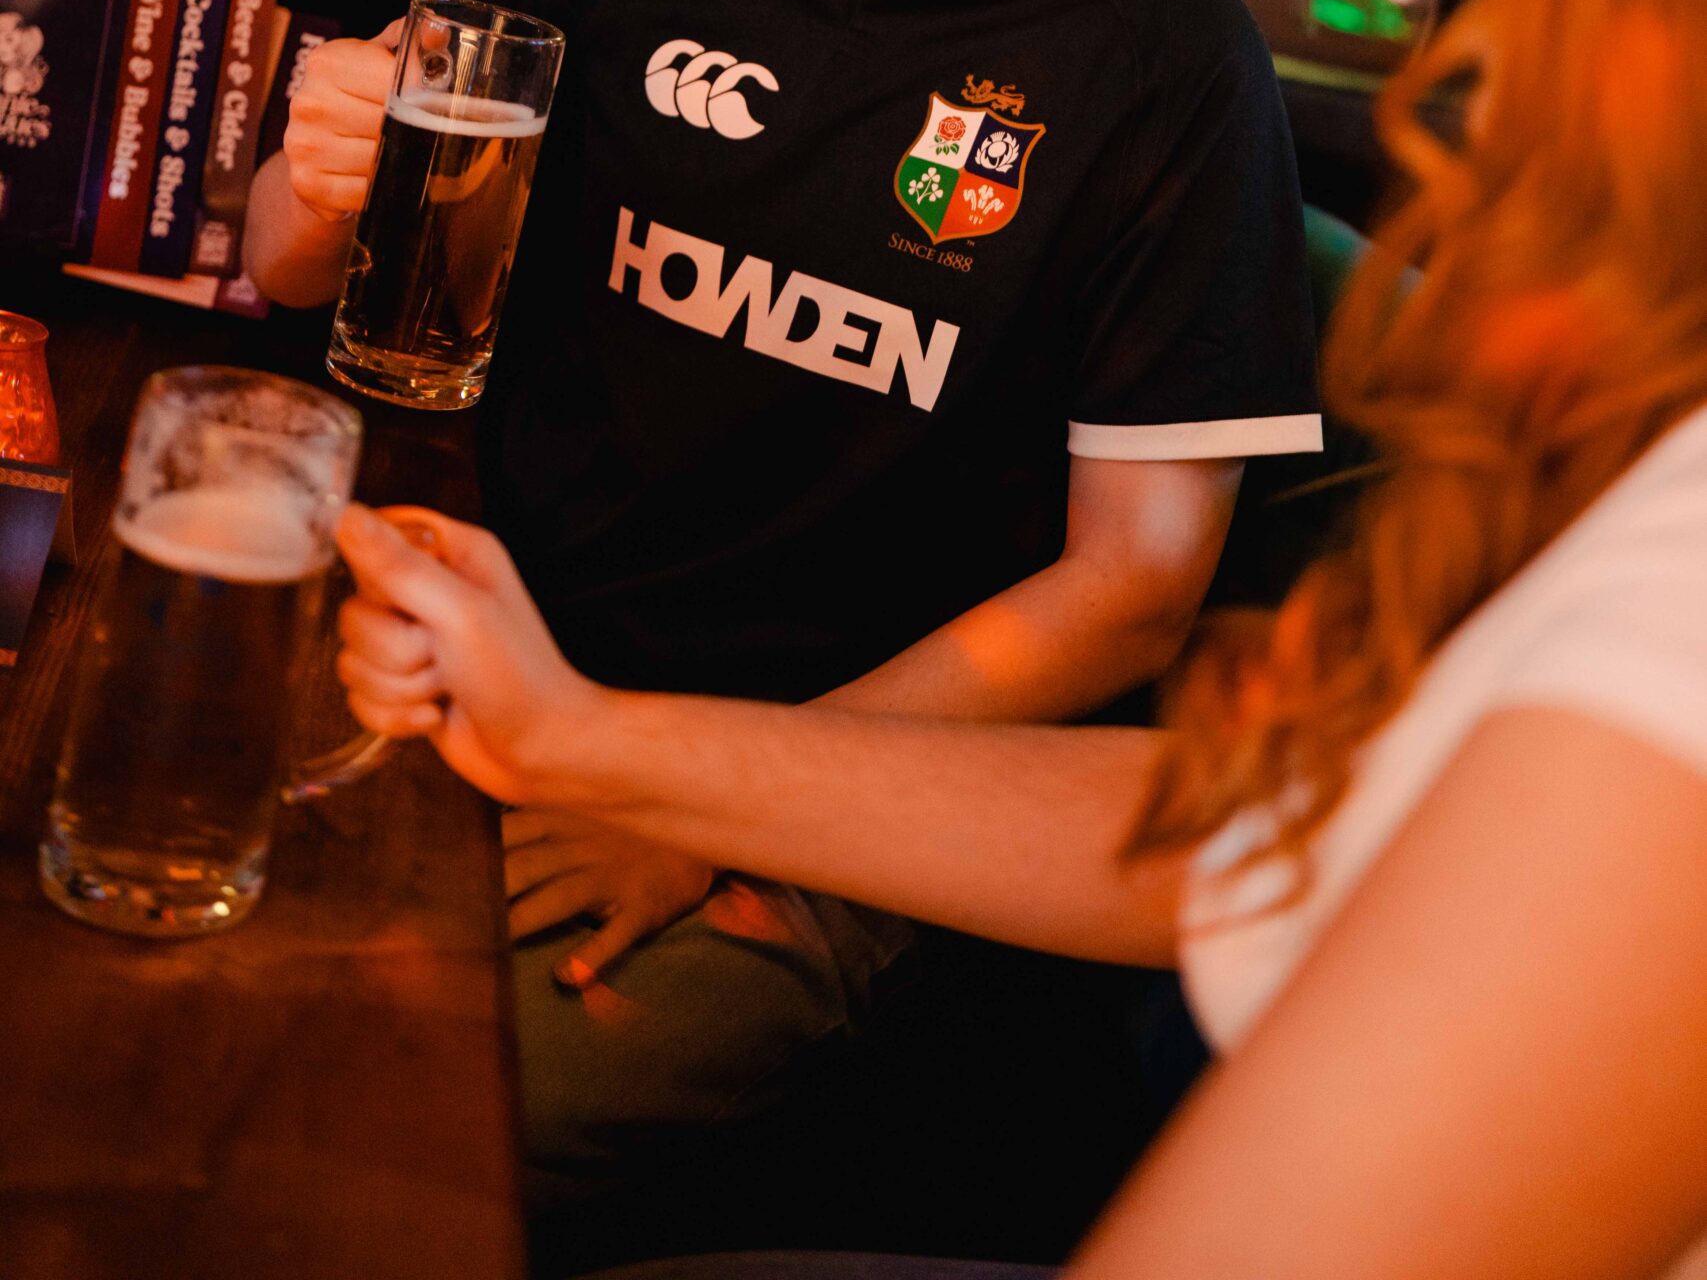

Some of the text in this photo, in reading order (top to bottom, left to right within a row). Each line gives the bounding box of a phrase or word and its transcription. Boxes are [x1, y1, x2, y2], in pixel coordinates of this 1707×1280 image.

[128, 56, 154, 82] &
[226, 60, 253, 86] &
[108, 84, 150, 200] Bubbles
[164, 125, 190, 152] &
[214, 89, 249, 171] Cider
[150, 154, 186, 238] Shots
[887, 231, 974, 273] SINCE 1888
[607, 205, 961, 413] HOWDEN
